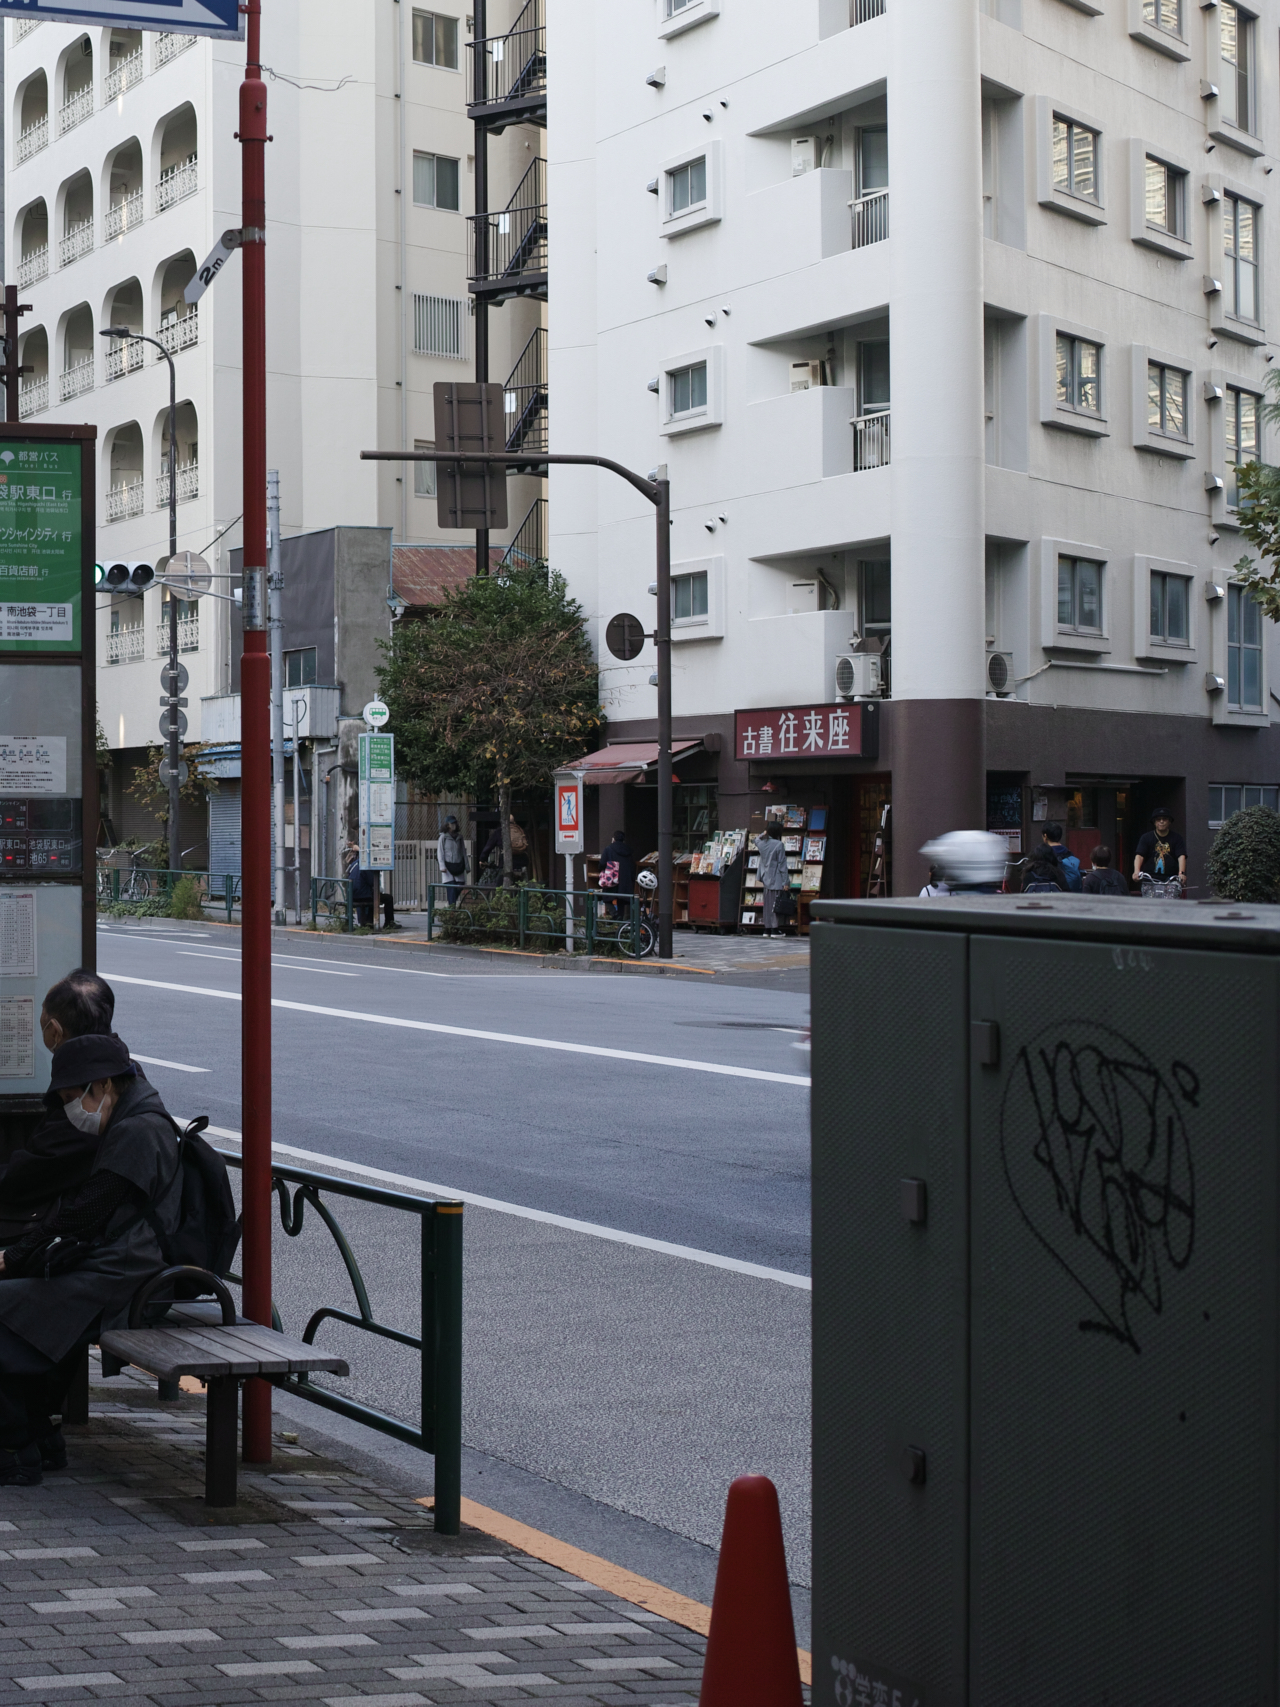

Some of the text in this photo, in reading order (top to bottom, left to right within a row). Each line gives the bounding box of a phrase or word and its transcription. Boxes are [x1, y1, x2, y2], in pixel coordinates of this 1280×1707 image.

[199, 258, 223, 286] 2m
[18, 451, 58, 461] 都営バス
[62, 490, 72, 500] 行
[62, 532, 72, 542] 行
[7, 606, 66, 618] 南池袋一丁目
[742, 709, 850, 754] 古書 往来座
[29, 839, 64, 850] 池袋駅東口
[29, 853, 47, 865] 池65
